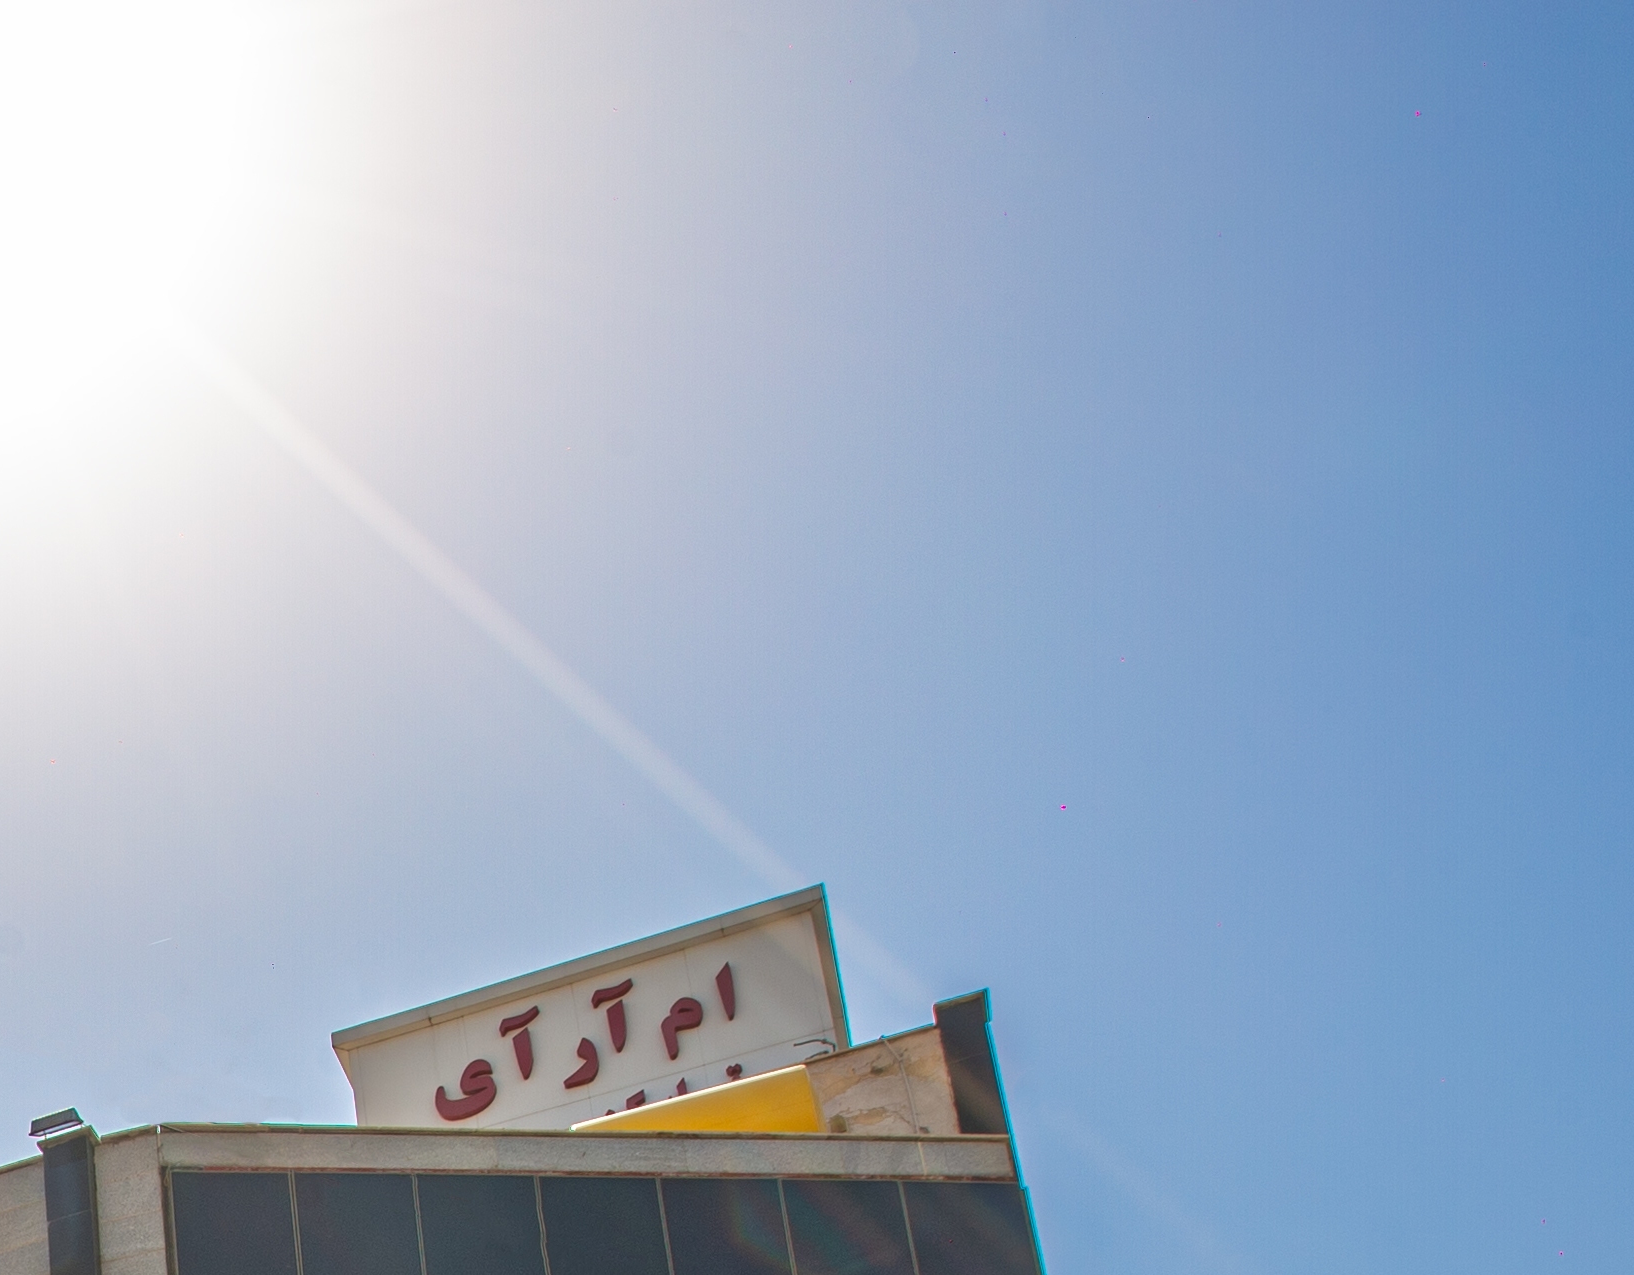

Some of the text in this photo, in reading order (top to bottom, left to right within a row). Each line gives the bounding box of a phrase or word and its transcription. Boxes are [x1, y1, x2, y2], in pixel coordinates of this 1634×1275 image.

[434, 1004, 540, 1122] آی
[563, 976, 633, 1090] آر
[660, 960, 736, 1061] ام
